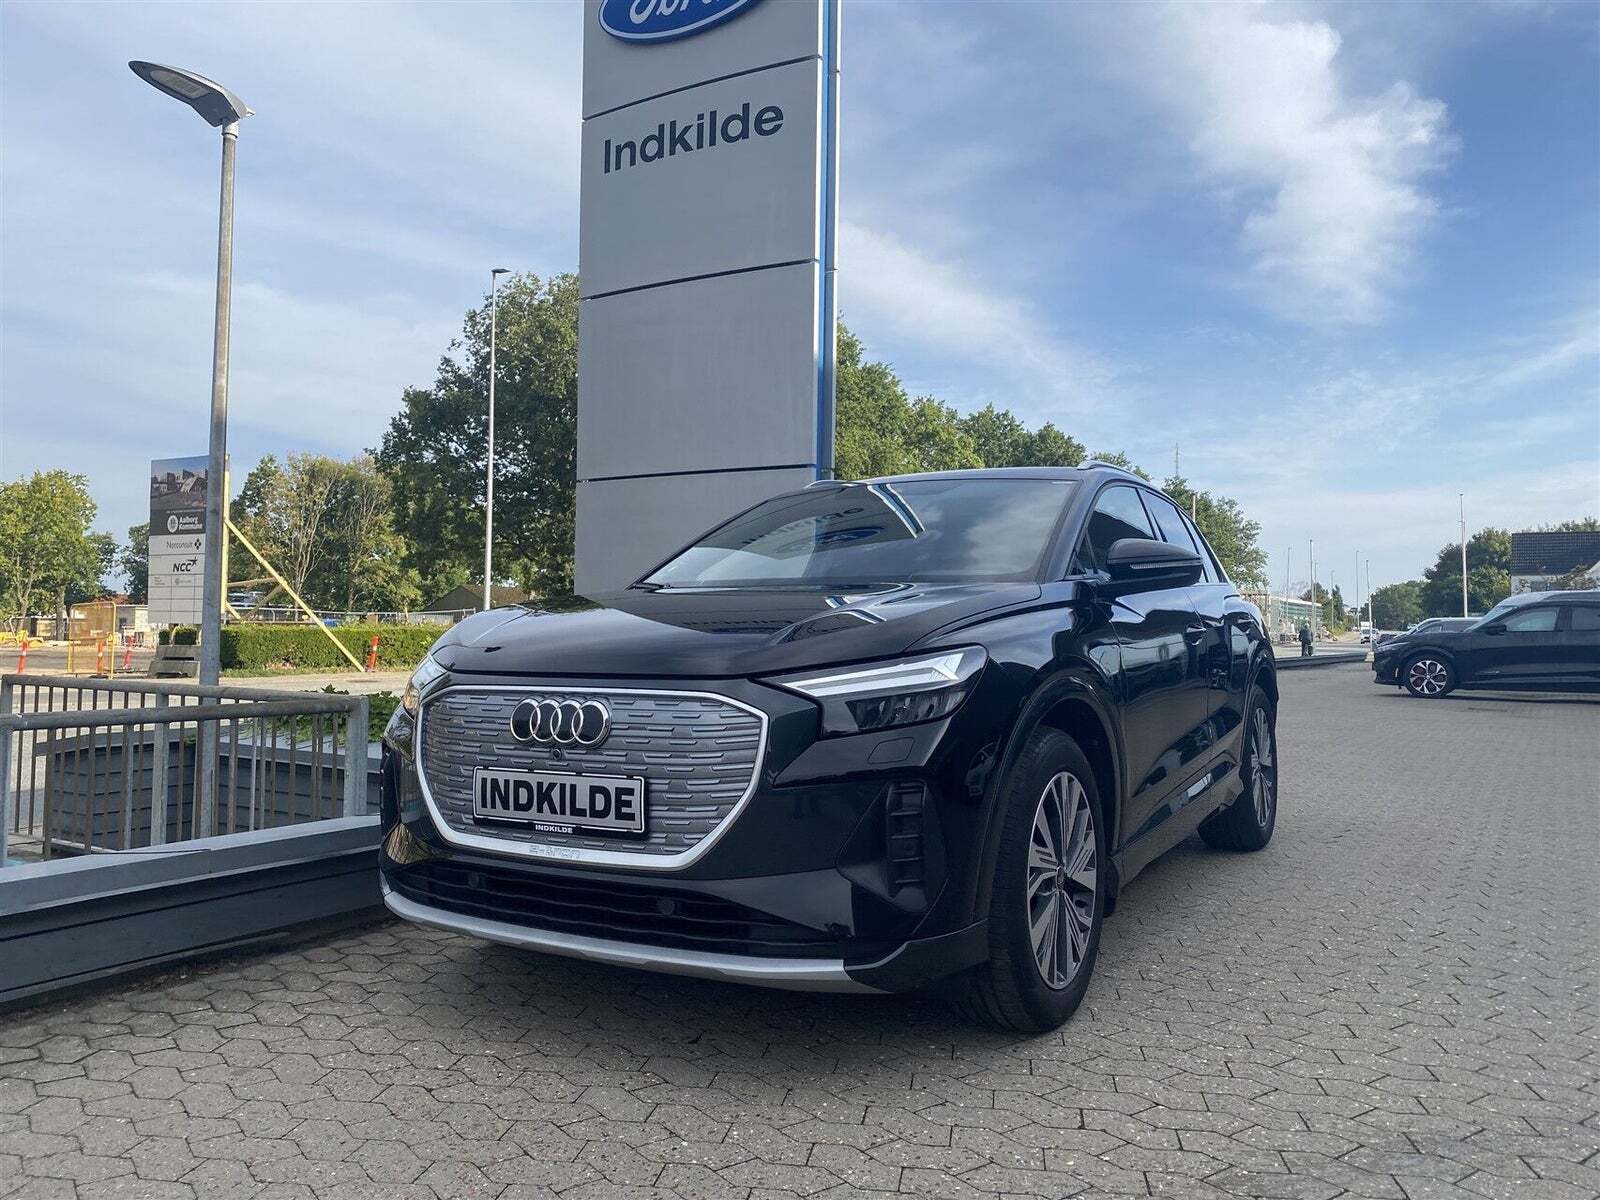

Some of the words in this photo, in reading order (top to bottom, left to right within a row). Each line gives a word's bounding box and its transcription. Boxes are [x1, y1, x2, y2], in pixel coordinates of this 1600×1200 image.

[603, 102, 784, 174] Indkilde
[172, 562, 191, 573] NCC
[480, 777, 636, 821] INDKILDE
[535, 824, 574, 834] INDKILDE
